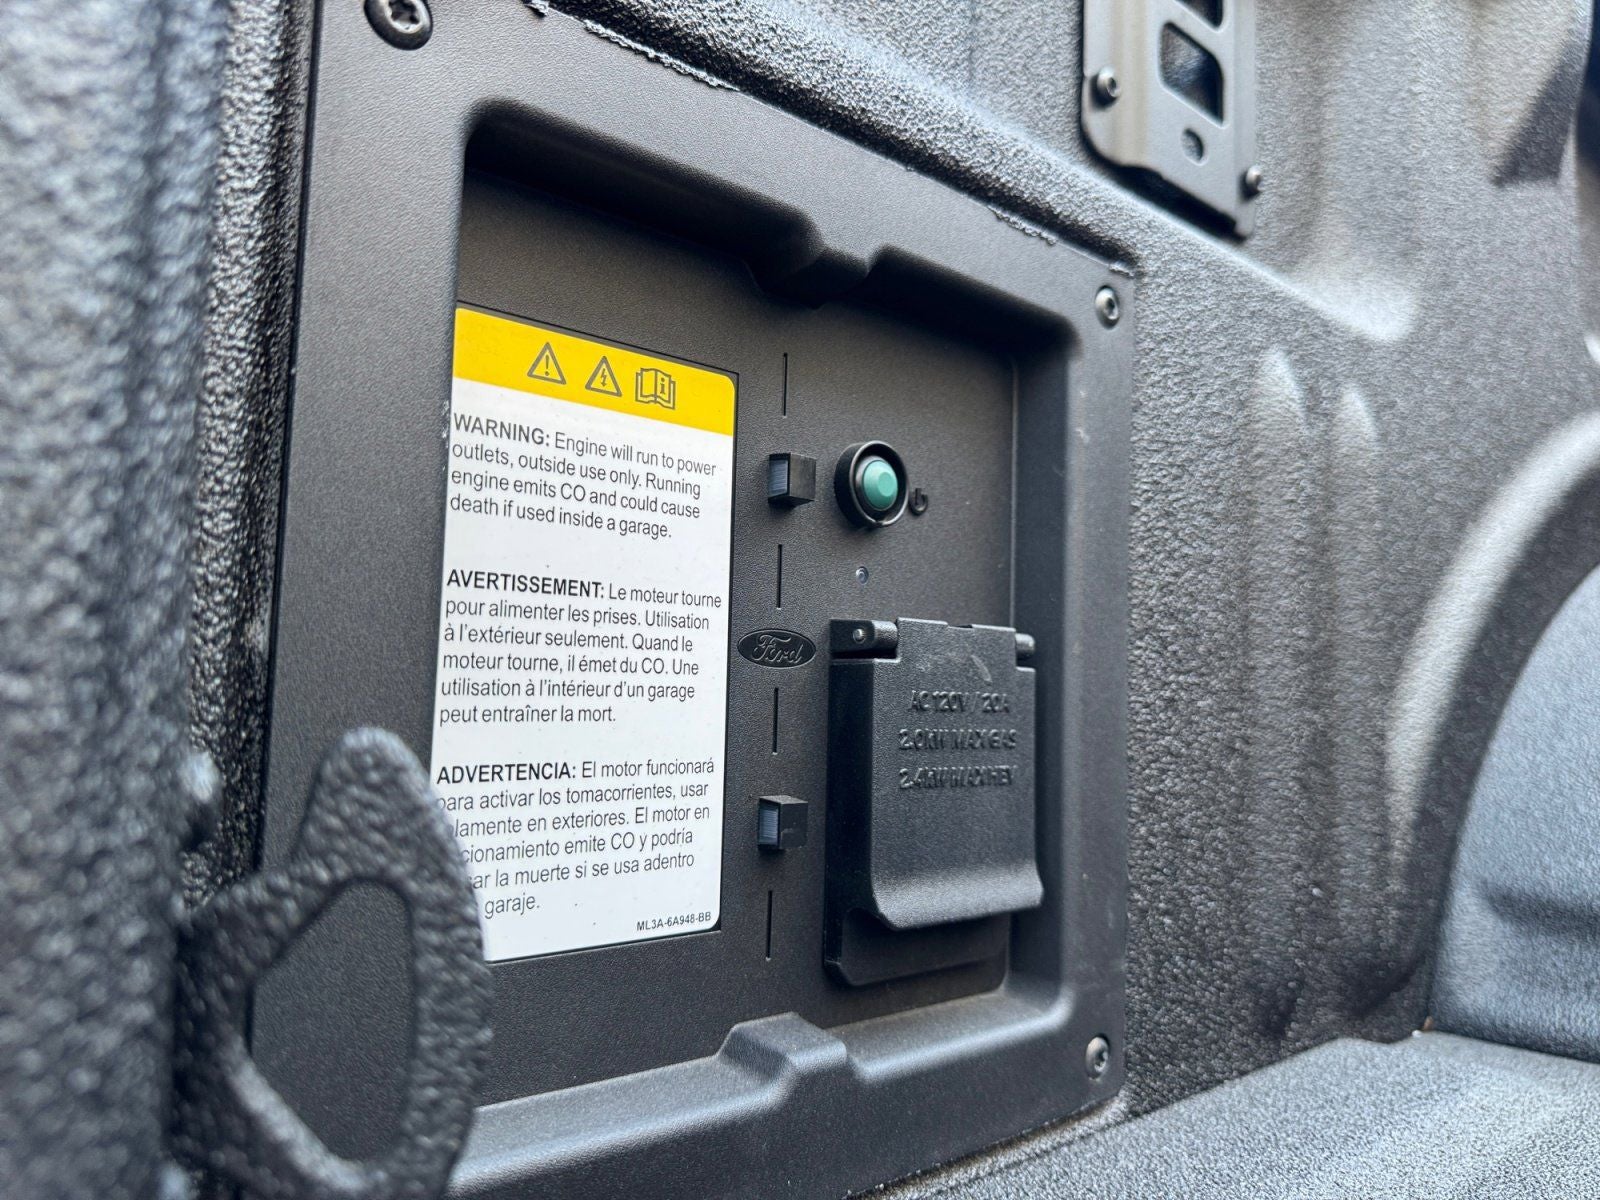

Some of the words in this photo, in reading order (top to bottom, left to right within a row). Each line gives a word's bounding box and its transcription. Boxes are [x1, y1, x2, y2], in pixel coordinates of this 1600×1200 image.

[454, 413, 550, 447] WARNING:
[555, 432, 607, 456] Engine
[610, 440, 633, 461] will
[637, 450, 658, 466] run
[662, 452, 673, 468] to
[677, 457, 716, 476] power
[452, 442, 513, 468] outlets,
[518, 454, 575, 475] outside
[580, 465, 606, 480] use
[610, 469, 641, 490] only.
[646, 473, 701, 499] Running
[451, 469, 509, 492] engine
[514, 478, 556, 498] emits
[560, 483, 585, 501] CO
[590, 489, 616, 507] and
[620, 494, 657, 512] could
[661, 502, 700, 518] cause
[451, 494, 498, 516] death
[504, 499, 513, 516] if
[517, 503, 555, 523] used
[559, 508, 603, 528] inside
[607, 517, 615, 530] a
[619, 518, 671, 540] garage.
[447, 569, 604, 598] AVERTISSEMENT:
[609, 582, 626, 600] Le
[631, 587, 678, 604] moteur
[681, 592, 721, 607] tourne
[446, 599, 485, 618] pour
[489, 601, 564, 620] alimenter
[568, 605, 589, 622] les
[593, 609, 641, 627] prises.
[646, 609, 709, 629] Utilisation
[444, 624, 454, 641] à
[545, 630, 628, 649] seulement.
[632, 634, 678, 652] Quand
[682, 636, 692, 651] le
[753, 635, 802, 663] Ford
[443, 653, 504, 670] moteur
[508, 654, 563, 674] tourne,
[568, 654, 575, 672] il
[579, 655, 617, 673] émet
[620, 657, 638, 674] du
[642, 658, 668, 675] CO.
[673, 659, 698, 675] Une
[442, 678, 521, 696] utilisation
[526, 679, 534, 696] à
[648, 685, 695, 702] garage
[440, 705, 477, 727] peut
[482, 705, 557, 723] entraîner
[561, 706, 573, 722] la
[578, 707, 616, 722] mort.
[989, 729, 1016, 749] GAS
[437, 762, 576, 784] ADVERTENCIA:
[582, 762, 596, 778] El
[601, 760, 642, 777] motor
[647, 757, 714, 776] funcionará
[480, 787, 534, 809] activar
[539, 786, 561, 804] los
[566, 783, 675, 804] tomacorrientes,
[681, 782, 708, 797] usar
[449, 816, 522, 837] lamente
[527, 816, 546, 831] en
[552, 806, 628, 830] exteriores.
[635, 807, 648, 823] El
[653, 805, 690, 821] motor
[694, 807, 710, 819] en
[565, 834, 606, 854] emite
[611, 832, 634, 849] CO
[639, 834, 647, 851] y
[651, 827, 692, 849] podría
[467, 873, 491, 889] ar
[495, 867, 509, 886] la
[515, 863, 569, 884] muerte
[575, 860, 587, 878] si
[592, 862, 609, 876] se
[614, 859, 639, 874] usa
[644, 851, 694, 871] adentro
[484, 893, 540, 918] garaje.
[637, 912, 711, 931] ML3A-6A948-BB
